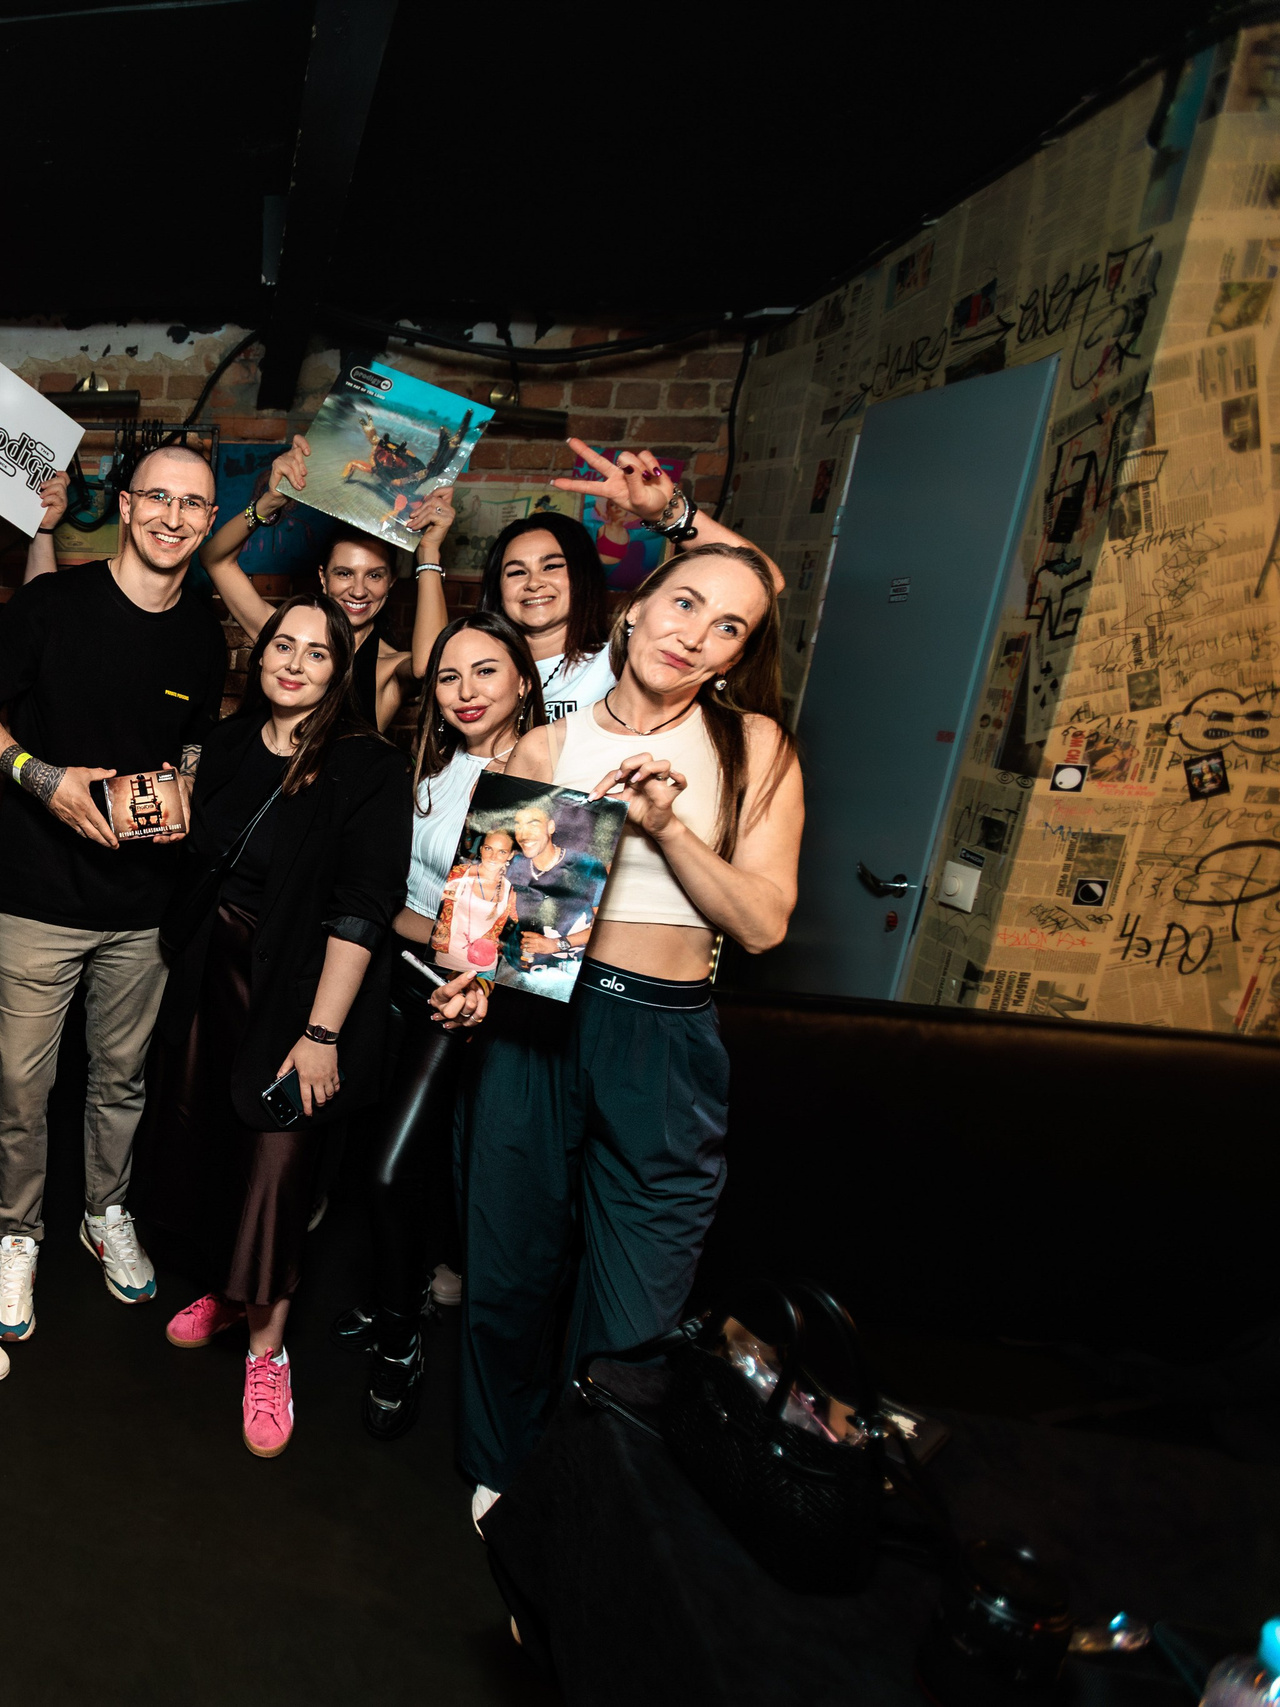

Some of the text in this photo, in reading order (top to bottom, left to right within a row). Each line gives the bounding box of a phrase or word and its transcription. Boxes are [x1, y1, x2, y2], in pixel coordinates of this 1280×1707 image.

[119, 830, 135, 838] BEYOND
[143, 825, 168, 834] REASONABLE
[600, 975, 625, 992] alo
[1012, 970, 1031, 1007] ВЫБОРЫ
